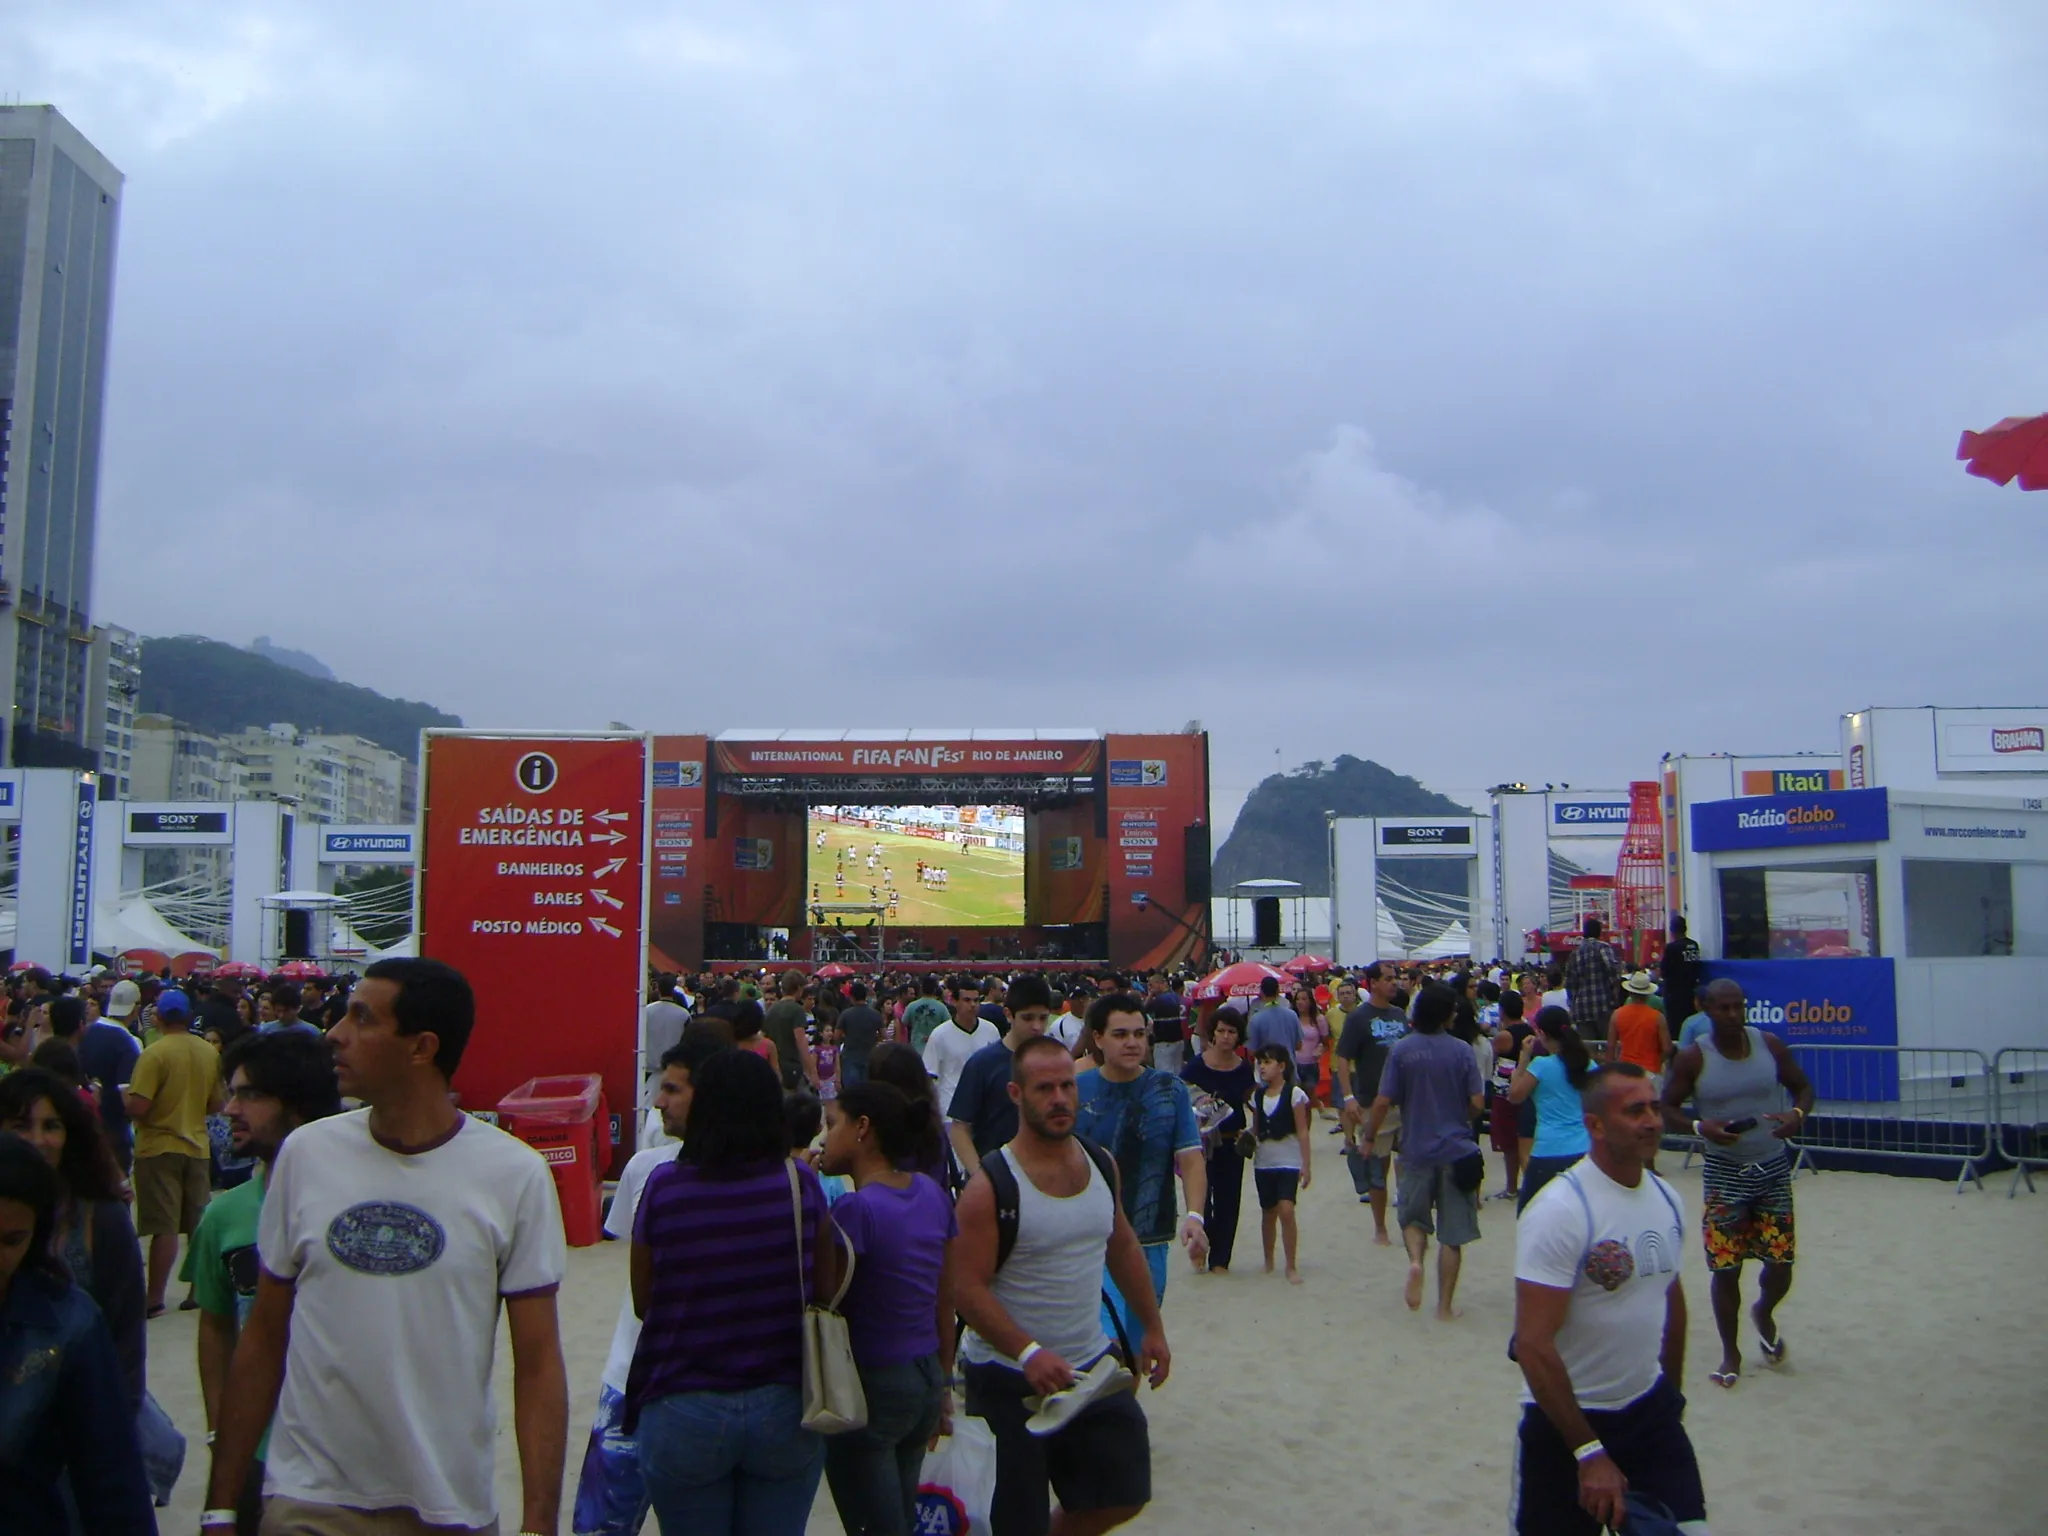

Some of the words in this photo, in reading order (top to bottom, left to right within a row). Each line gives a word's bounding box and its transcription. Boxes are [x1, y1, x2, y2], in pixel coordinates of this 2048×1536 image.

[1995, 730, 2041, 750] BRAHMA
[751, 751, 844, 761] INTERNATIONAL
[853, 748, 892, 765] FIFA
[972, 750, 993, 761] RIO
[995, 750, 1010, 761] DE
[1013, 750, 1063, 761] JANEIRO
[1779, 772, 1824, 792] Itaú
[158, 814, 199, 824] SONY
[479, 803, 553, 825] SAÍDAS
[559, 808, 584, 825] DE
[1588, 807, 1631, 819] HYUN
[459, 825, 584, 846] EMERGÊNCIA
[1407, 828, 1445, 837] SONY
[353, 838, 406, 849] HYUNDAI
[498, 861, 584, 876] BANHEIROS
[74, 825, 90, 948] HYUNDAI
[533, 892, 583, 905] BARES
[472, 919, 522, 933] POSTO
[526, 917, 582, 934] MÉDICO
